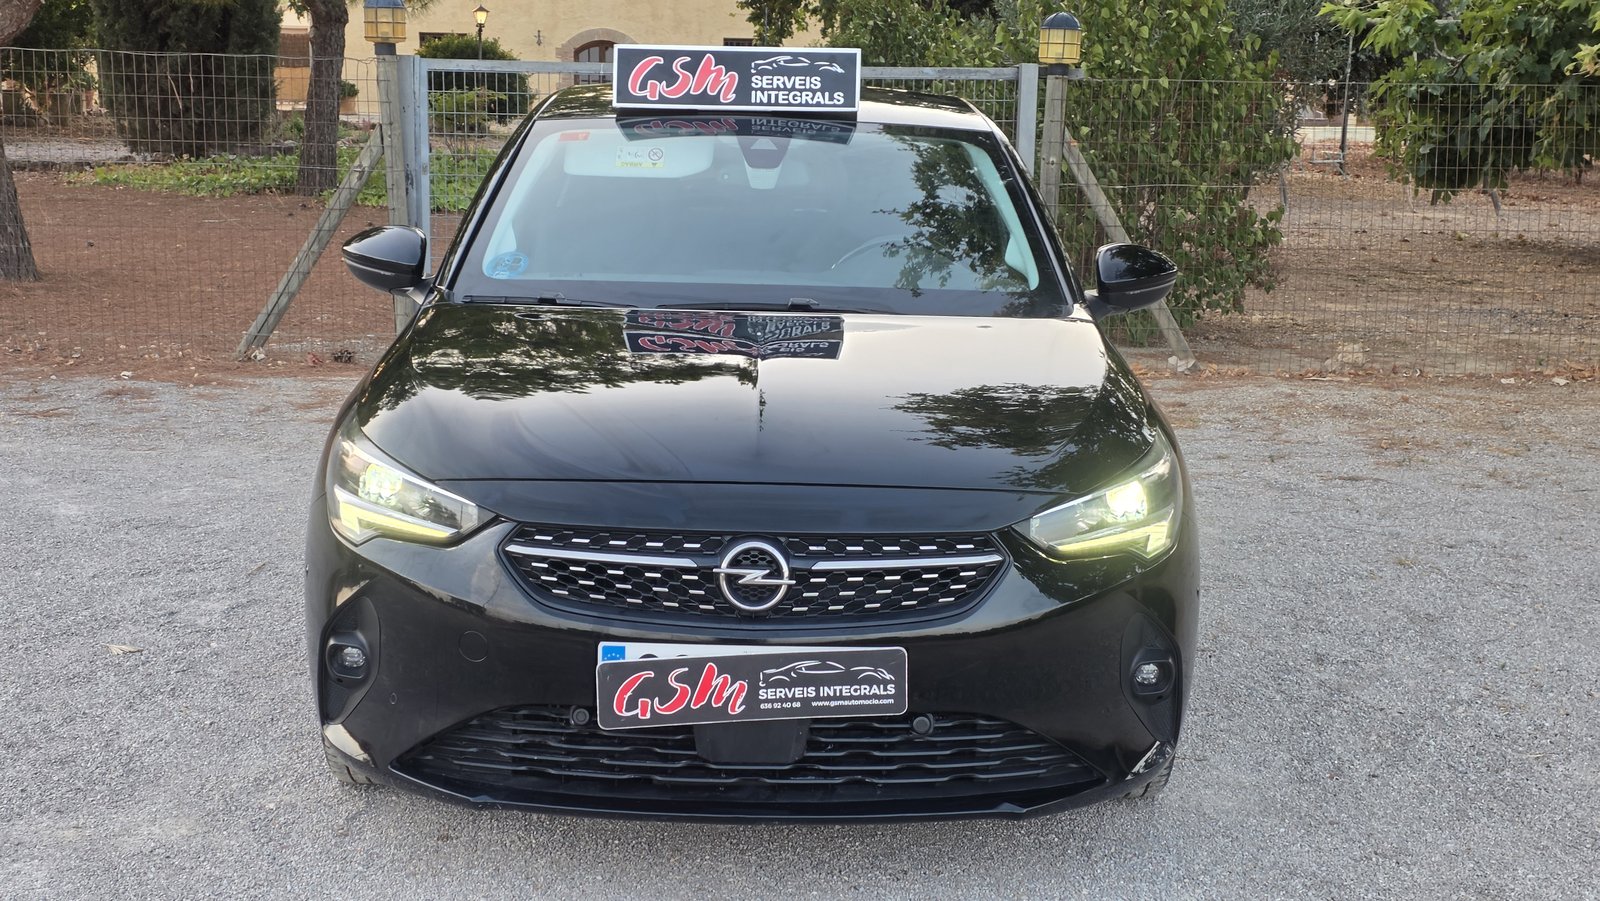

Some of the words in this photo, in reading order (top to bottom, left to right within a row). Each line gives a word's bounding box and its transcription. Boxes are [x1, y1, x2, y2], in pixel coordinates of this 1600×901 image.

[751, 75, 821, 89] SERVEIS
[751, 90, 844, 105] INTEGRALS
[759, 687, 815, 699] SERVEIS
[820, 685, 895, 697] INTEGRALS
[811, 699, 894, 707] www.gsmautomocio.com
